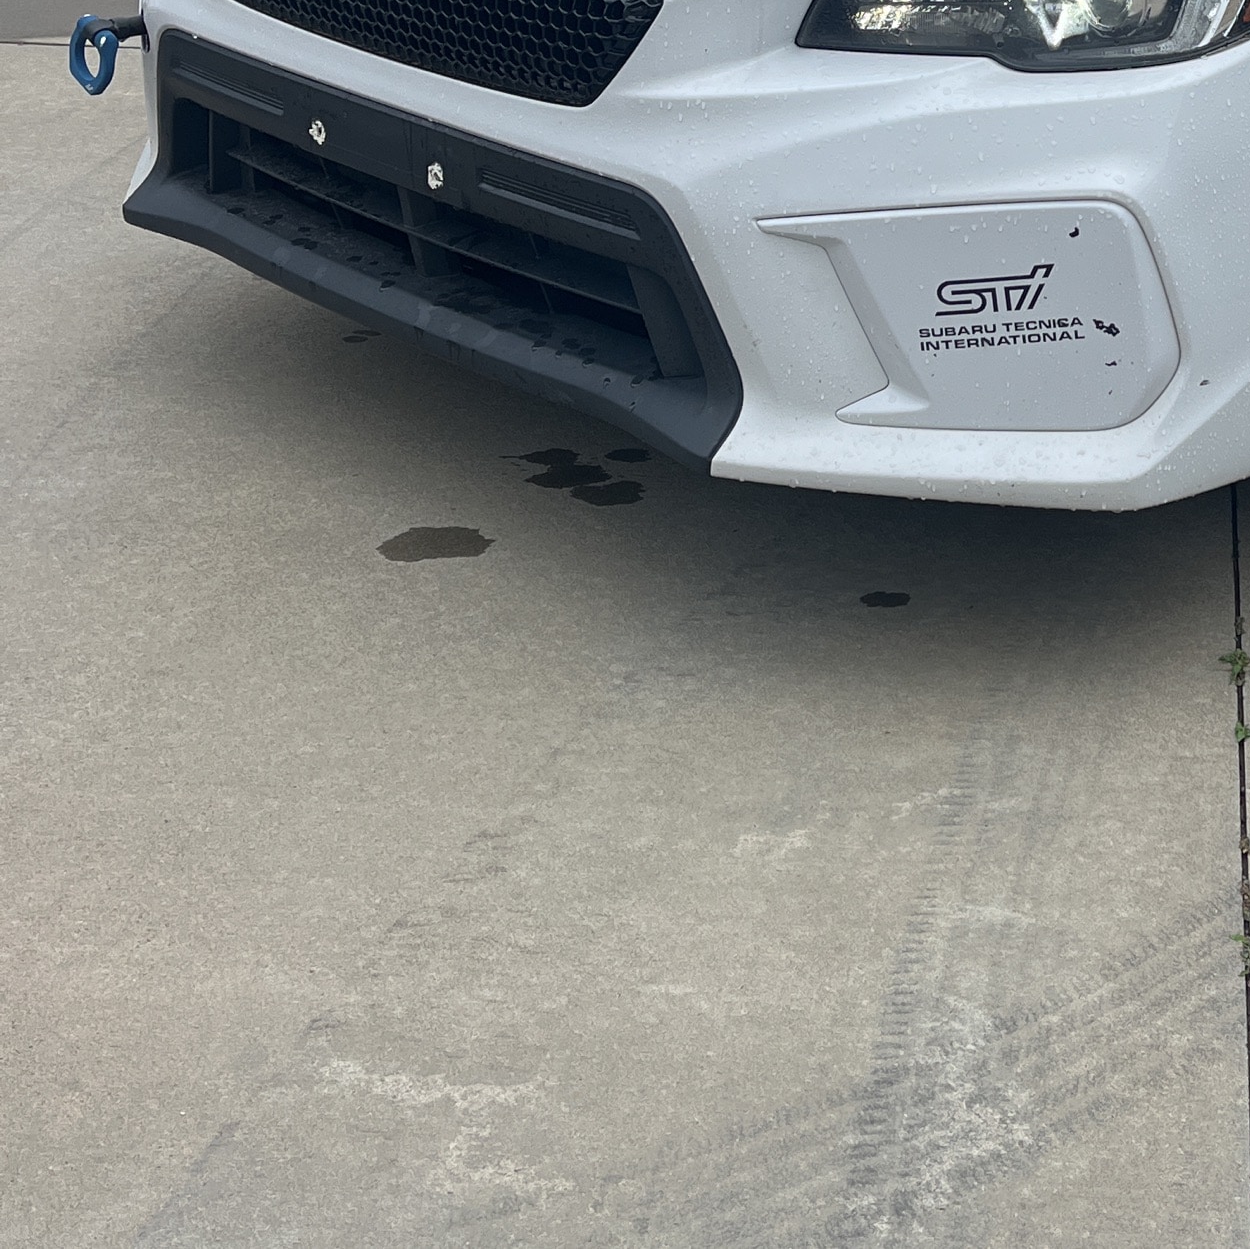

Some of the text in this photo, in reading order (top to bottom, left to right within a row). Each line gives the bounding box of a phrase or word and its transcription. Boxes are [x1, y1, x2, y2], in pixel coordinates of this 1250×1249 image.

[919, 317, 1084, 338] SUBARU TECNICA
[920, 329, 1085, 351] INTERNATIONAL
